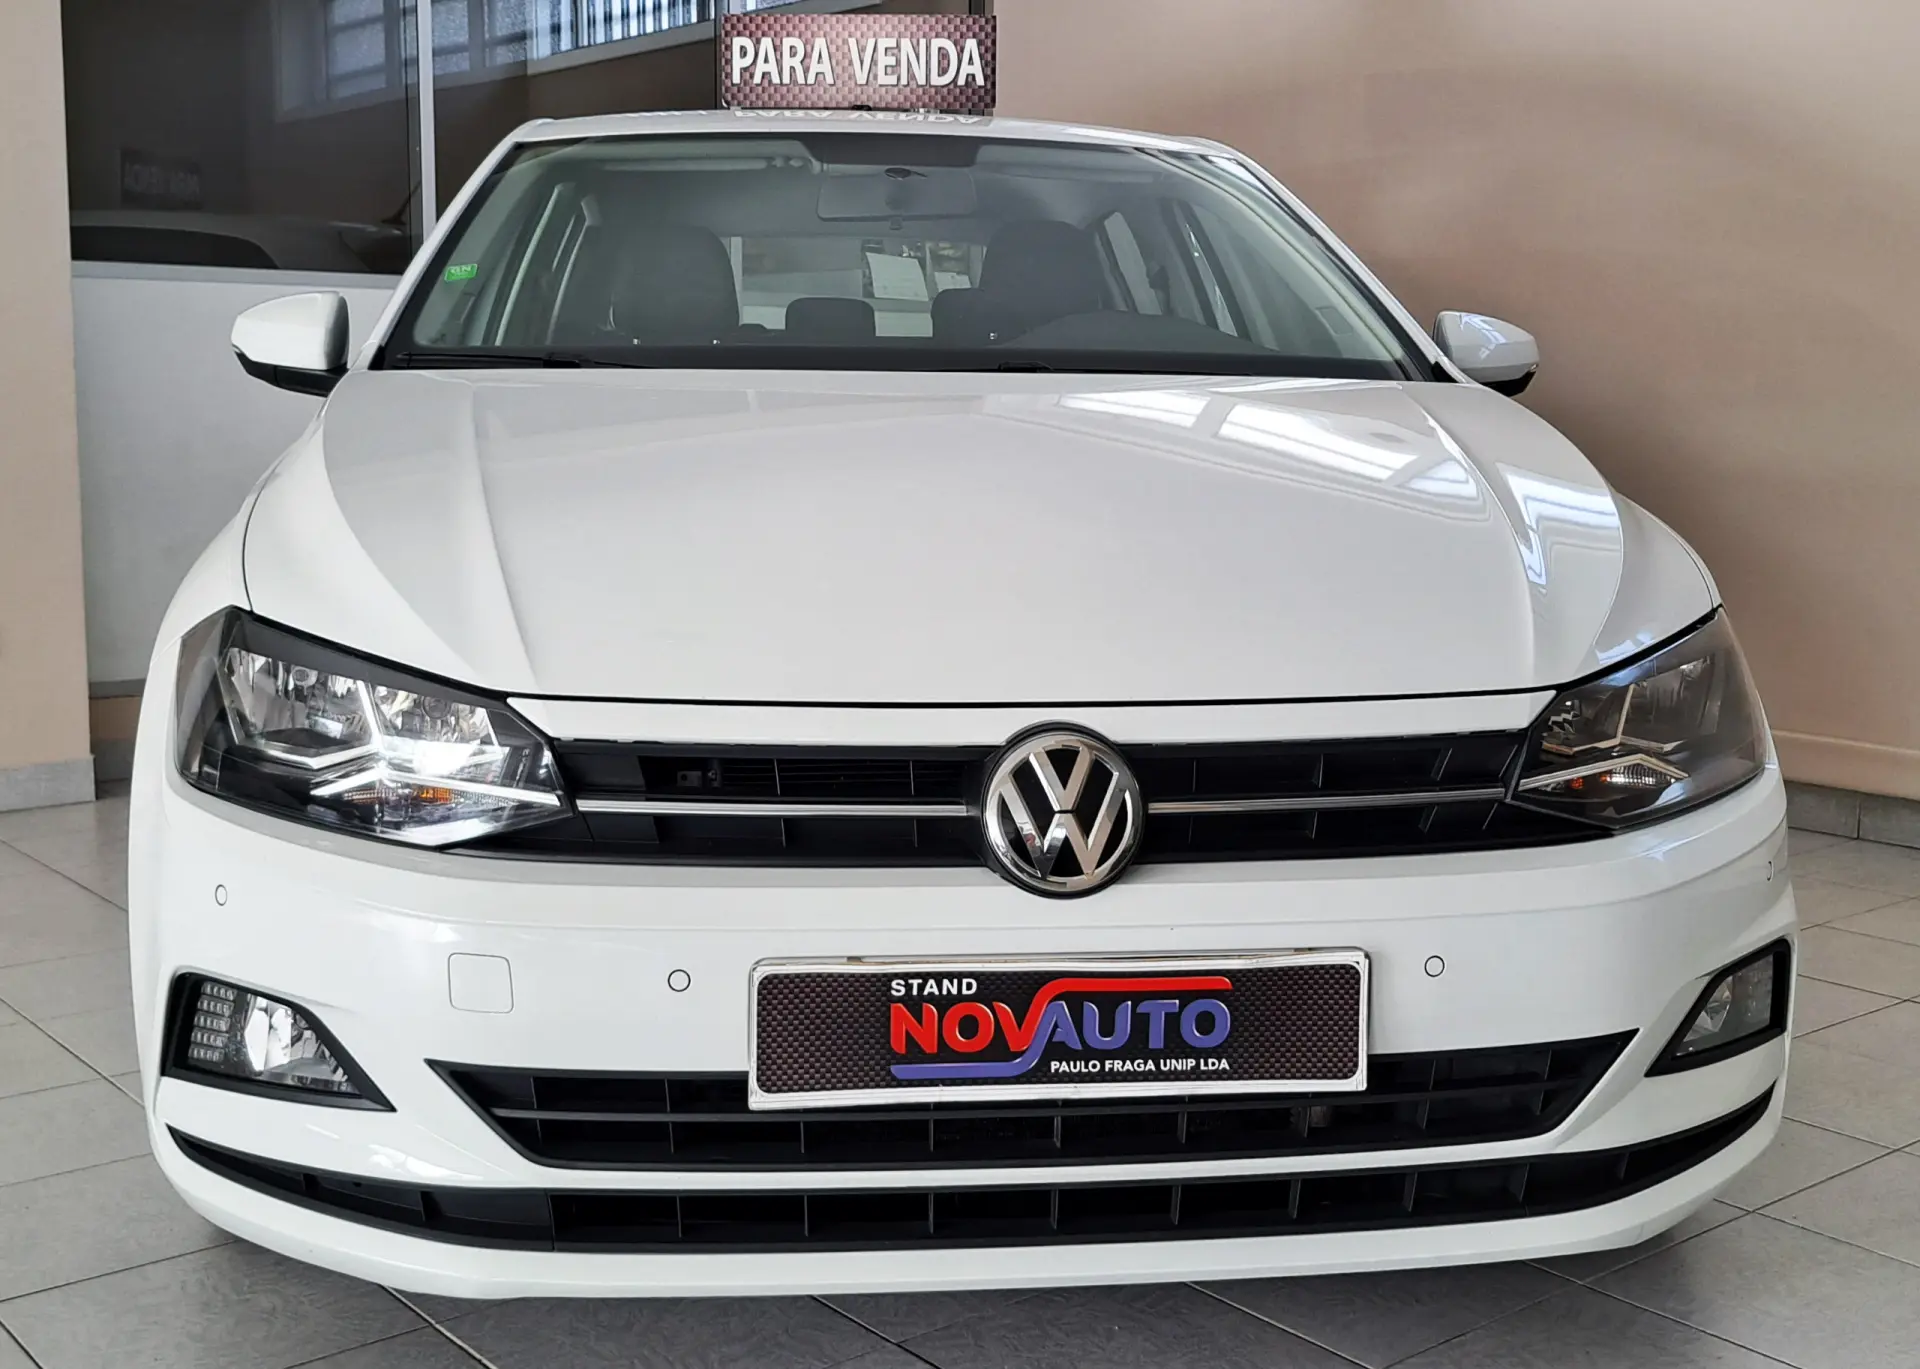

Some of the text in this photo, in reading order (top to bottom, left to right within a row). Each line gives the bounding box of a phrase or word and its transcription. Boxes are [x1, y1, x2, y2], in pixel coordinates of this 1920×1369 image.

[732, 36, 985, 87] PARA VENDA
[890, 978, 978, 997] STAND
[889, 998, 1231, 1054] NOVAUTO
[1050, 1058, 1231, 1074] PAULO FRAGA UNIP LDA
